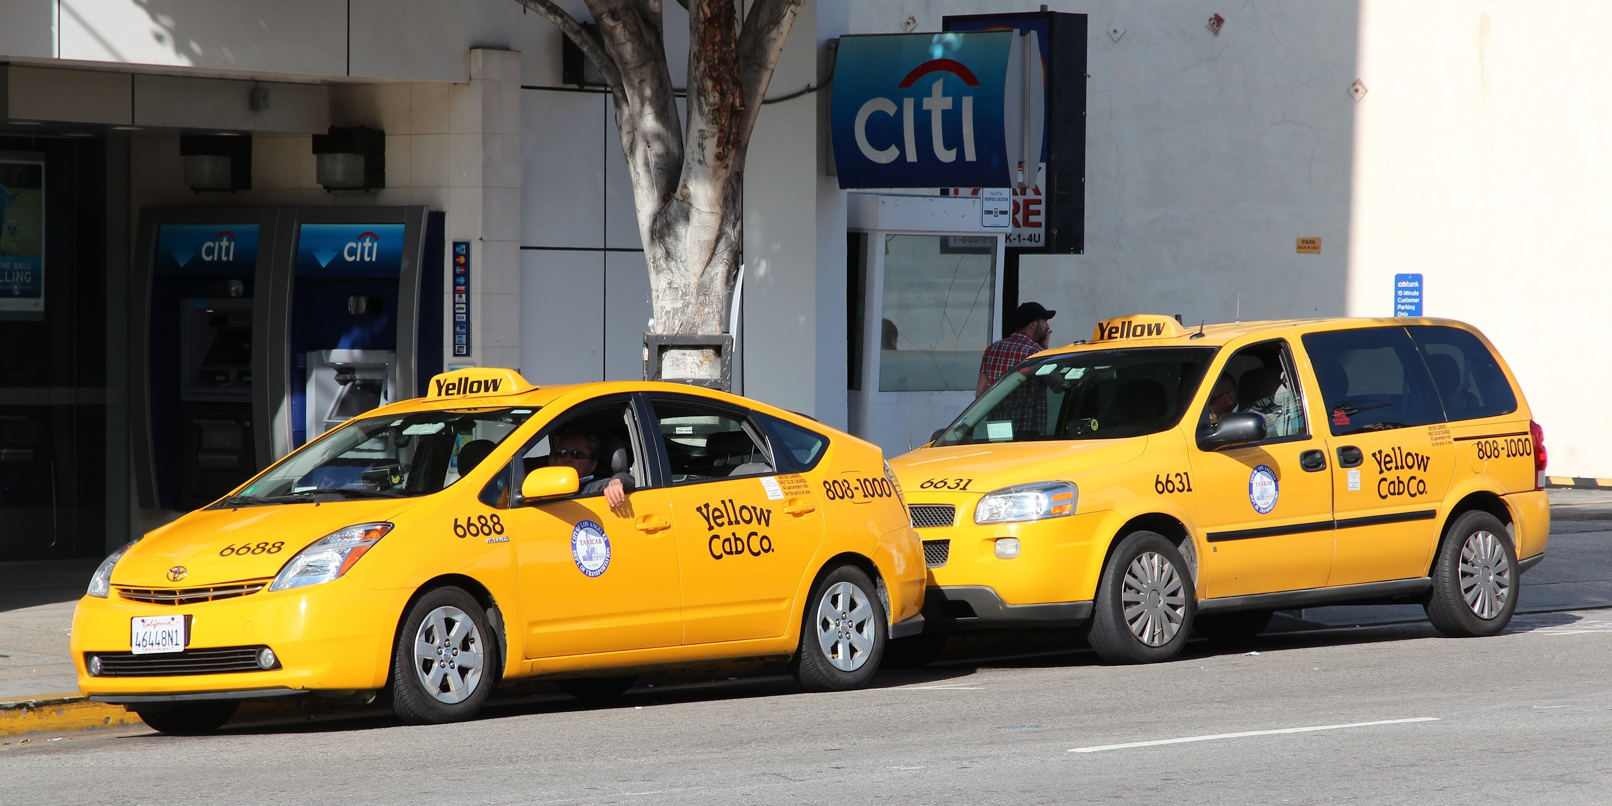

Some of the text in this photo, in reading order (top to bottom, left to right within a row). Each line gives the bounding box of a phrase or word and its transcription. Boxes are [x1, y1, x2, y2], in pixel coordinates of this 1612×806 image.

[854, 77, 977, 165] citi
[201, 236, 235, 262] citi
[343, 236, 377, 262] citi
[13, 262, 31, 270] BALL
[1398, 280, 1420, 288] citibank
[1097, 320, 1166, 340] Yellow
[435, 376, 503, 397] Yellow
[1476, 437, 1532, 460] 808-1000
[1371, 446, 1430, 475] Yellow
[822, 477, 892, 501] 808-1000
[919, 478, 973, 491] 6631
[1155, 472, 1192, 495] 6631
[1377, 475, 1427, 500] Cab Co.
[453, 513, 504, 539] 6688
[695, 498, 772, 532] Yellow
[579, 538, 603, 546] TAXICAB
[590, 521, 608, 541] ANGELES
[219, 541, 285, 557] 6688
[708, 531, 775, 560] Cab Co.
[585, 547, 611, 577] TRANSPORTATION
[142, 618, 174, 629] California
[135, 629, 180, 649] 46448N1
